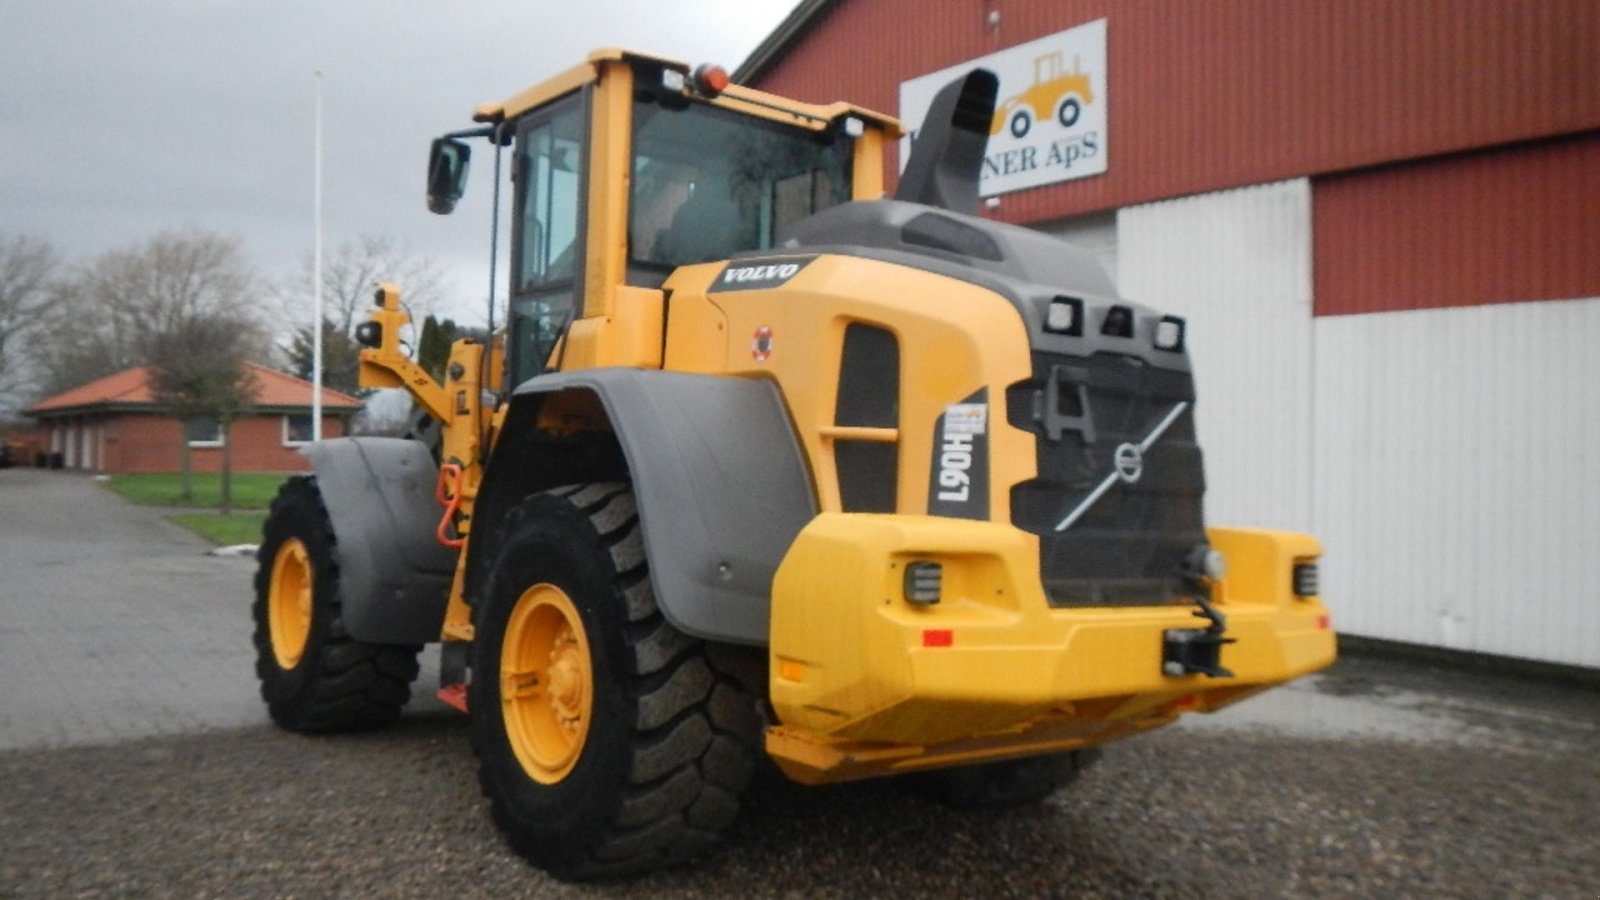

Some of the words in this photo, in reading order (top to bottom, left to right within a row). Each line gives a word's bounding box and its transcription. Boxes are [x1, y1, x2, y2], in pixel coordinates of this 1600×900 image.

[981, 146, 1037, 180] NER
[1044, 131, 1098, 169] ApS
[724, 264, 799, 283] VOLVO
[938, 433, 973, 501] L90H
